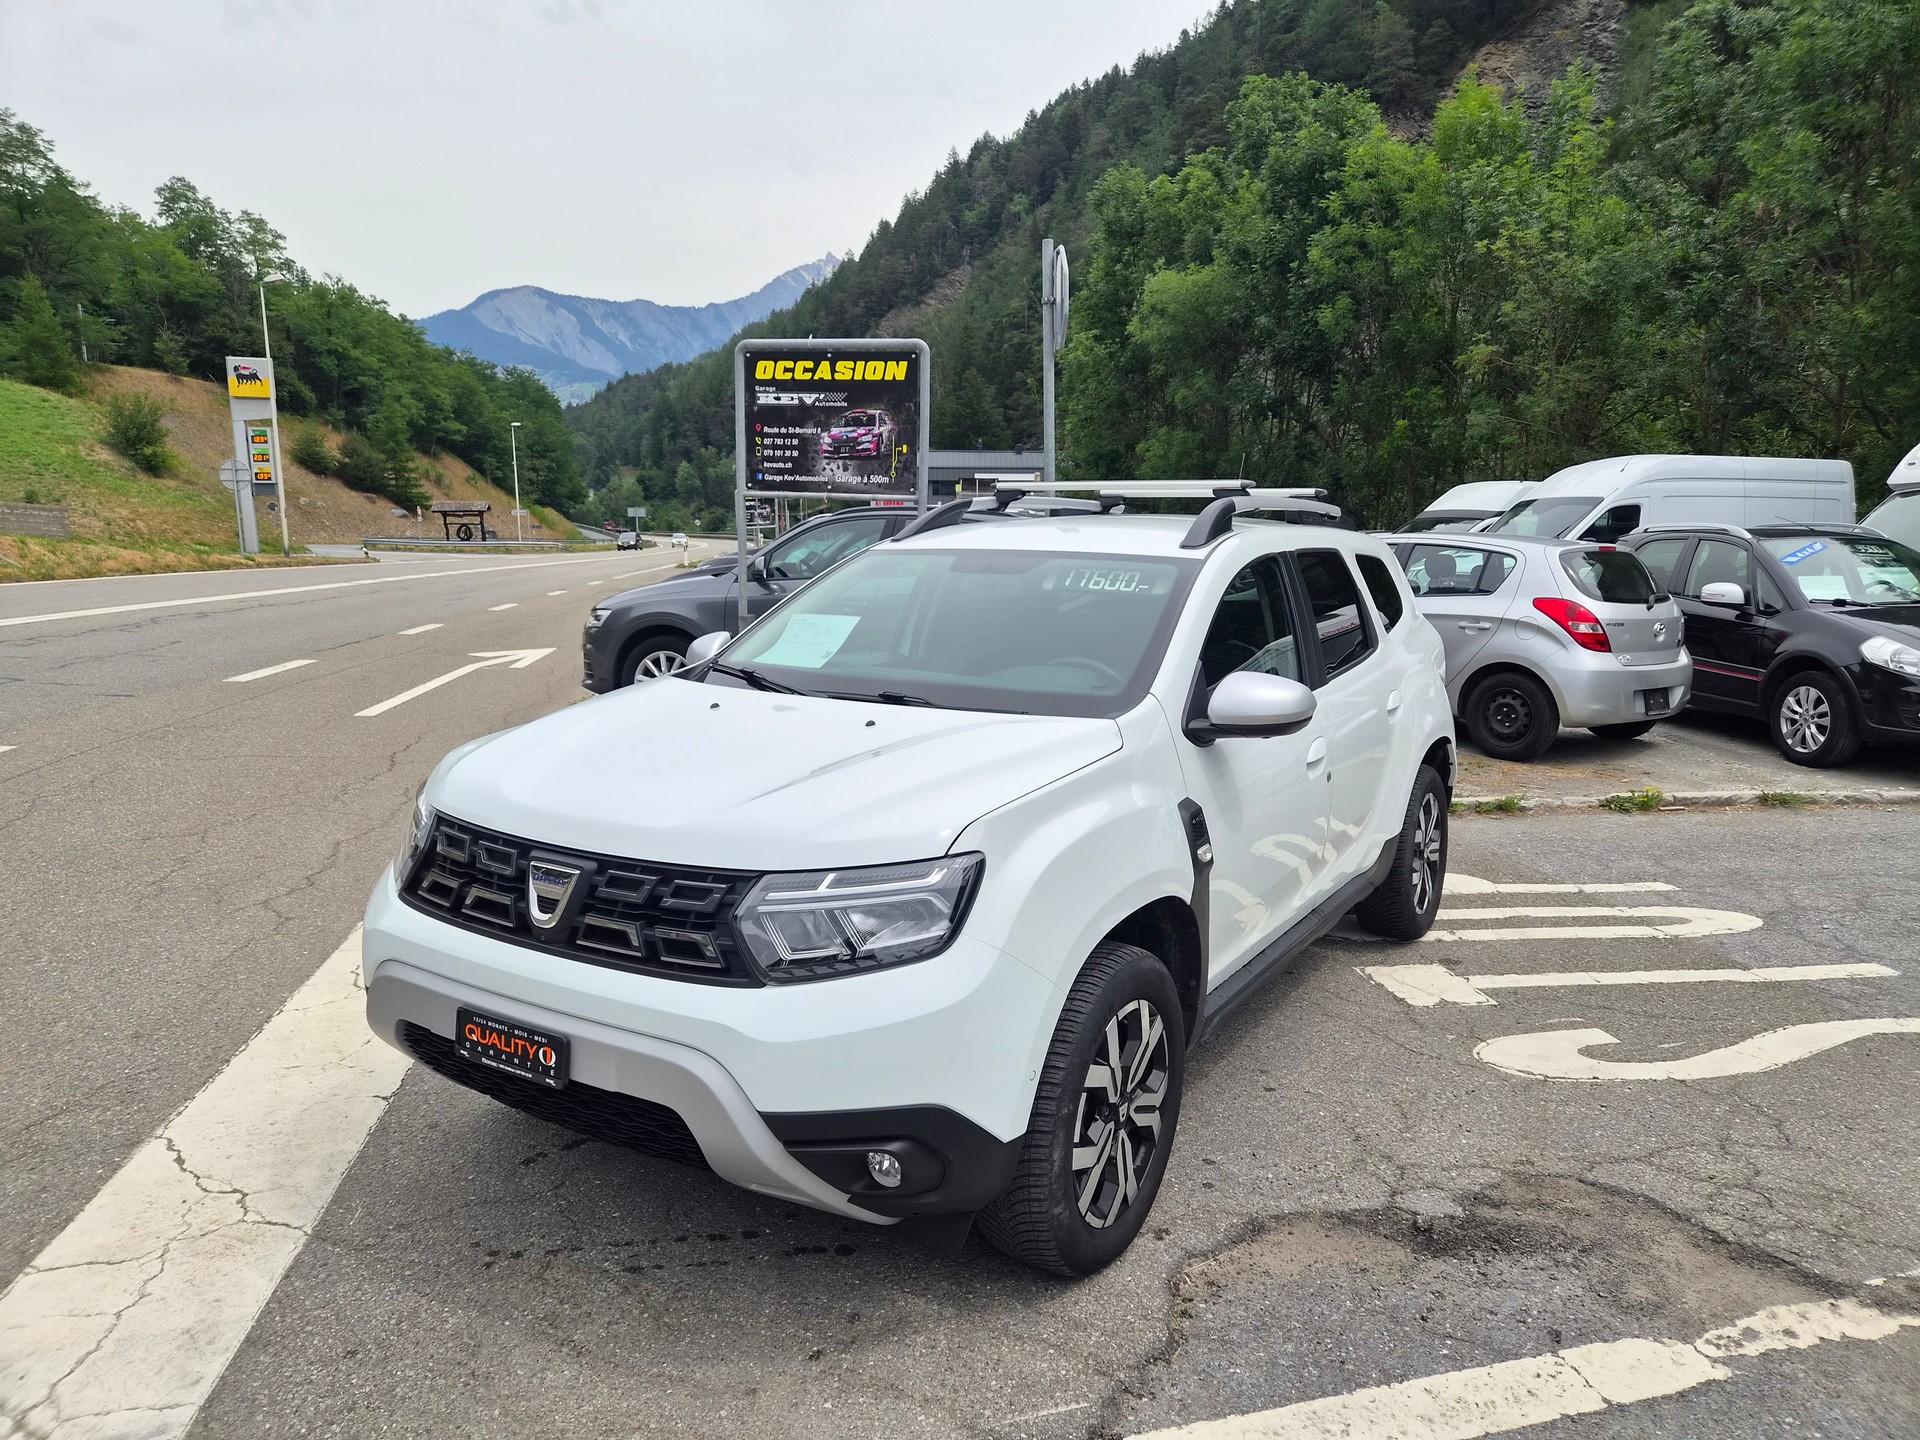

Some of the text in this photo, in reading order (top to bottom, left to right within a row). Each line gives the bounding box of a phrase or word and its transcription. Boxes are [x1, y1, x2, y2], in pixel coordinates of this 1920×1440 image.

[754, 360, 908, 381] OCCASION
[763, 460, 793, 469] kevauto.ch
[764, 473, 783, 482] Garage
[835, 474, 890, 484] Garage à 500m
[532, 873, 566, 886] DACIA
[472, 1016, 487, 1025] 12/24
[487, 1021, 508, 1032] MONATE
[514, 1029, 528, 1038] MOIS
[534, 1035, 548, 1044] MESI
[465, 1023, 538, 1060] QUALITY
[465, 1042, 555, 1076] GARANTIE
